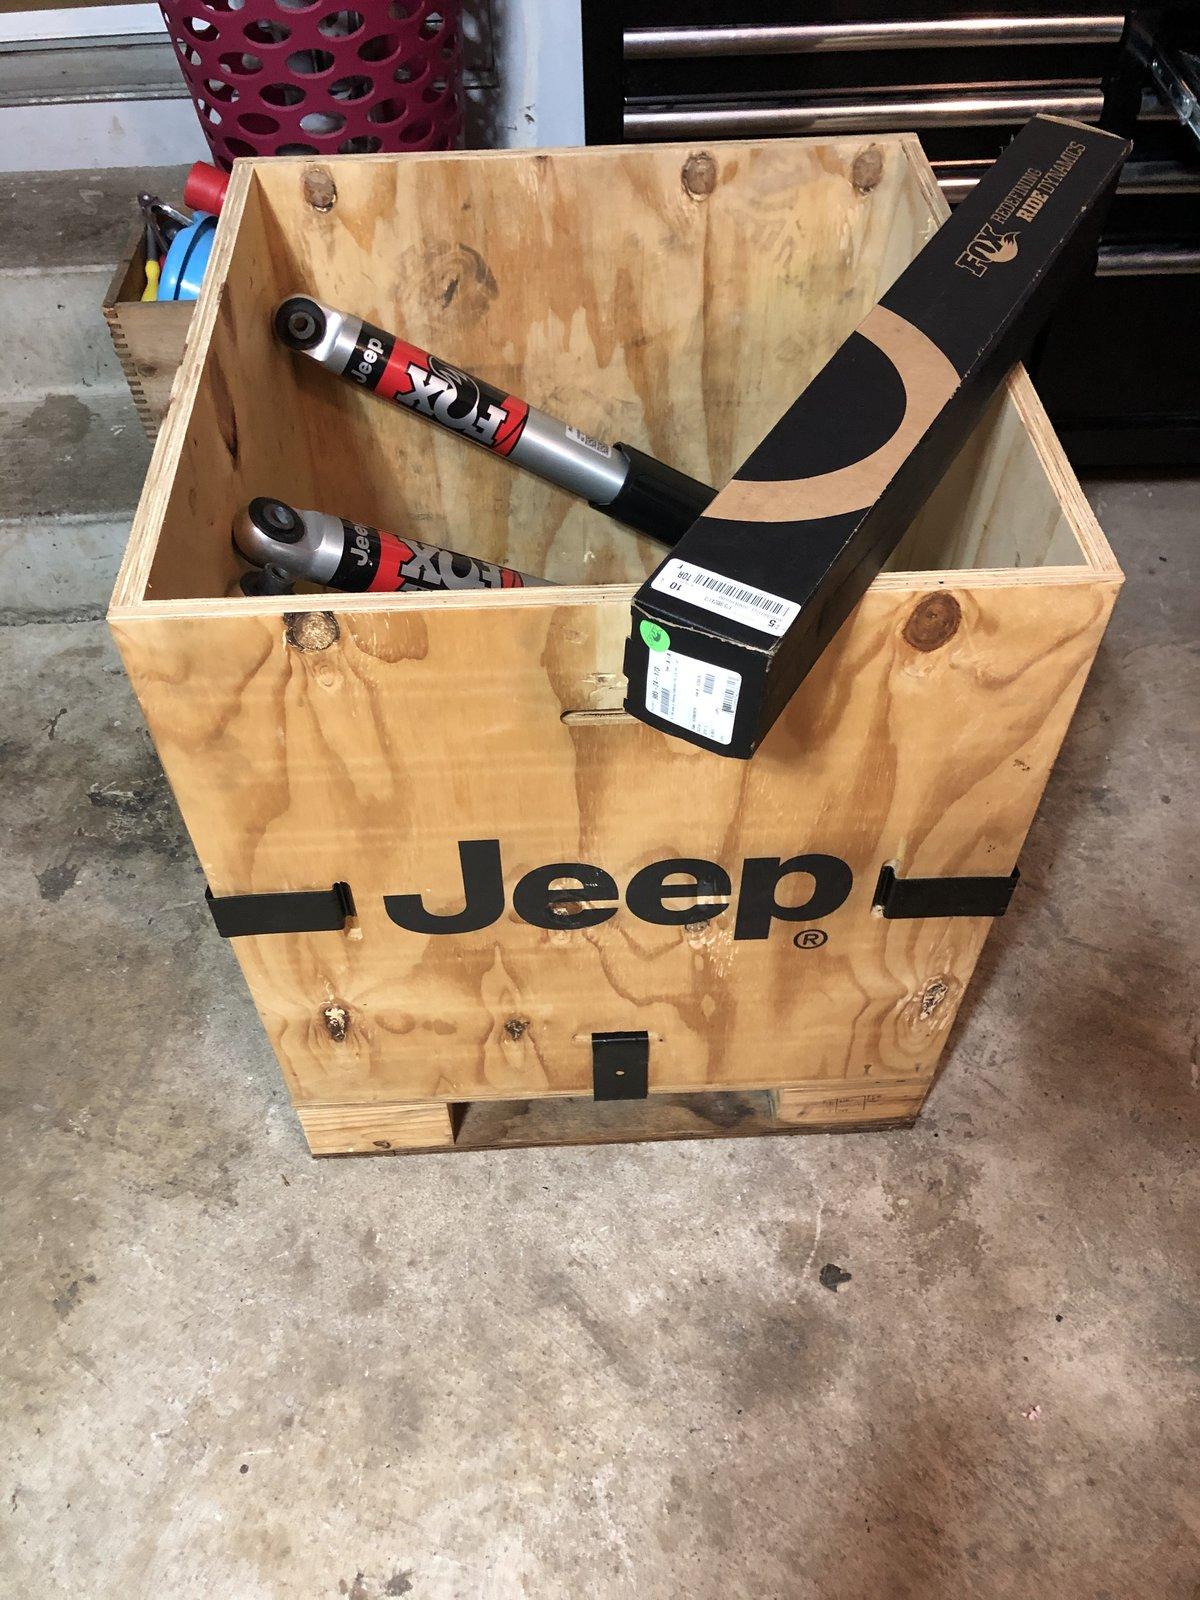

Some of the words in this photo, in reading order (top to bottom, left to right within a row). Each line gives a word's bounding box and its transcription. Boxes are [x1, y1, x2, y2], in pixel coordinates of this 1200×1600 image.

[991, 167, 1043, 224] REDEFINING
[1015, 193, 1049, 223] RIDE
[1042, 140, 1086, 194] DYNAMICS
[954, 222, 1009, 278] FOX
[351, 337, 384, 384] Jeep
[396, 364, 508, 447] FOX
[350, 525, 370, 567] Jee
[383, 838, 854, 941] Jeep
